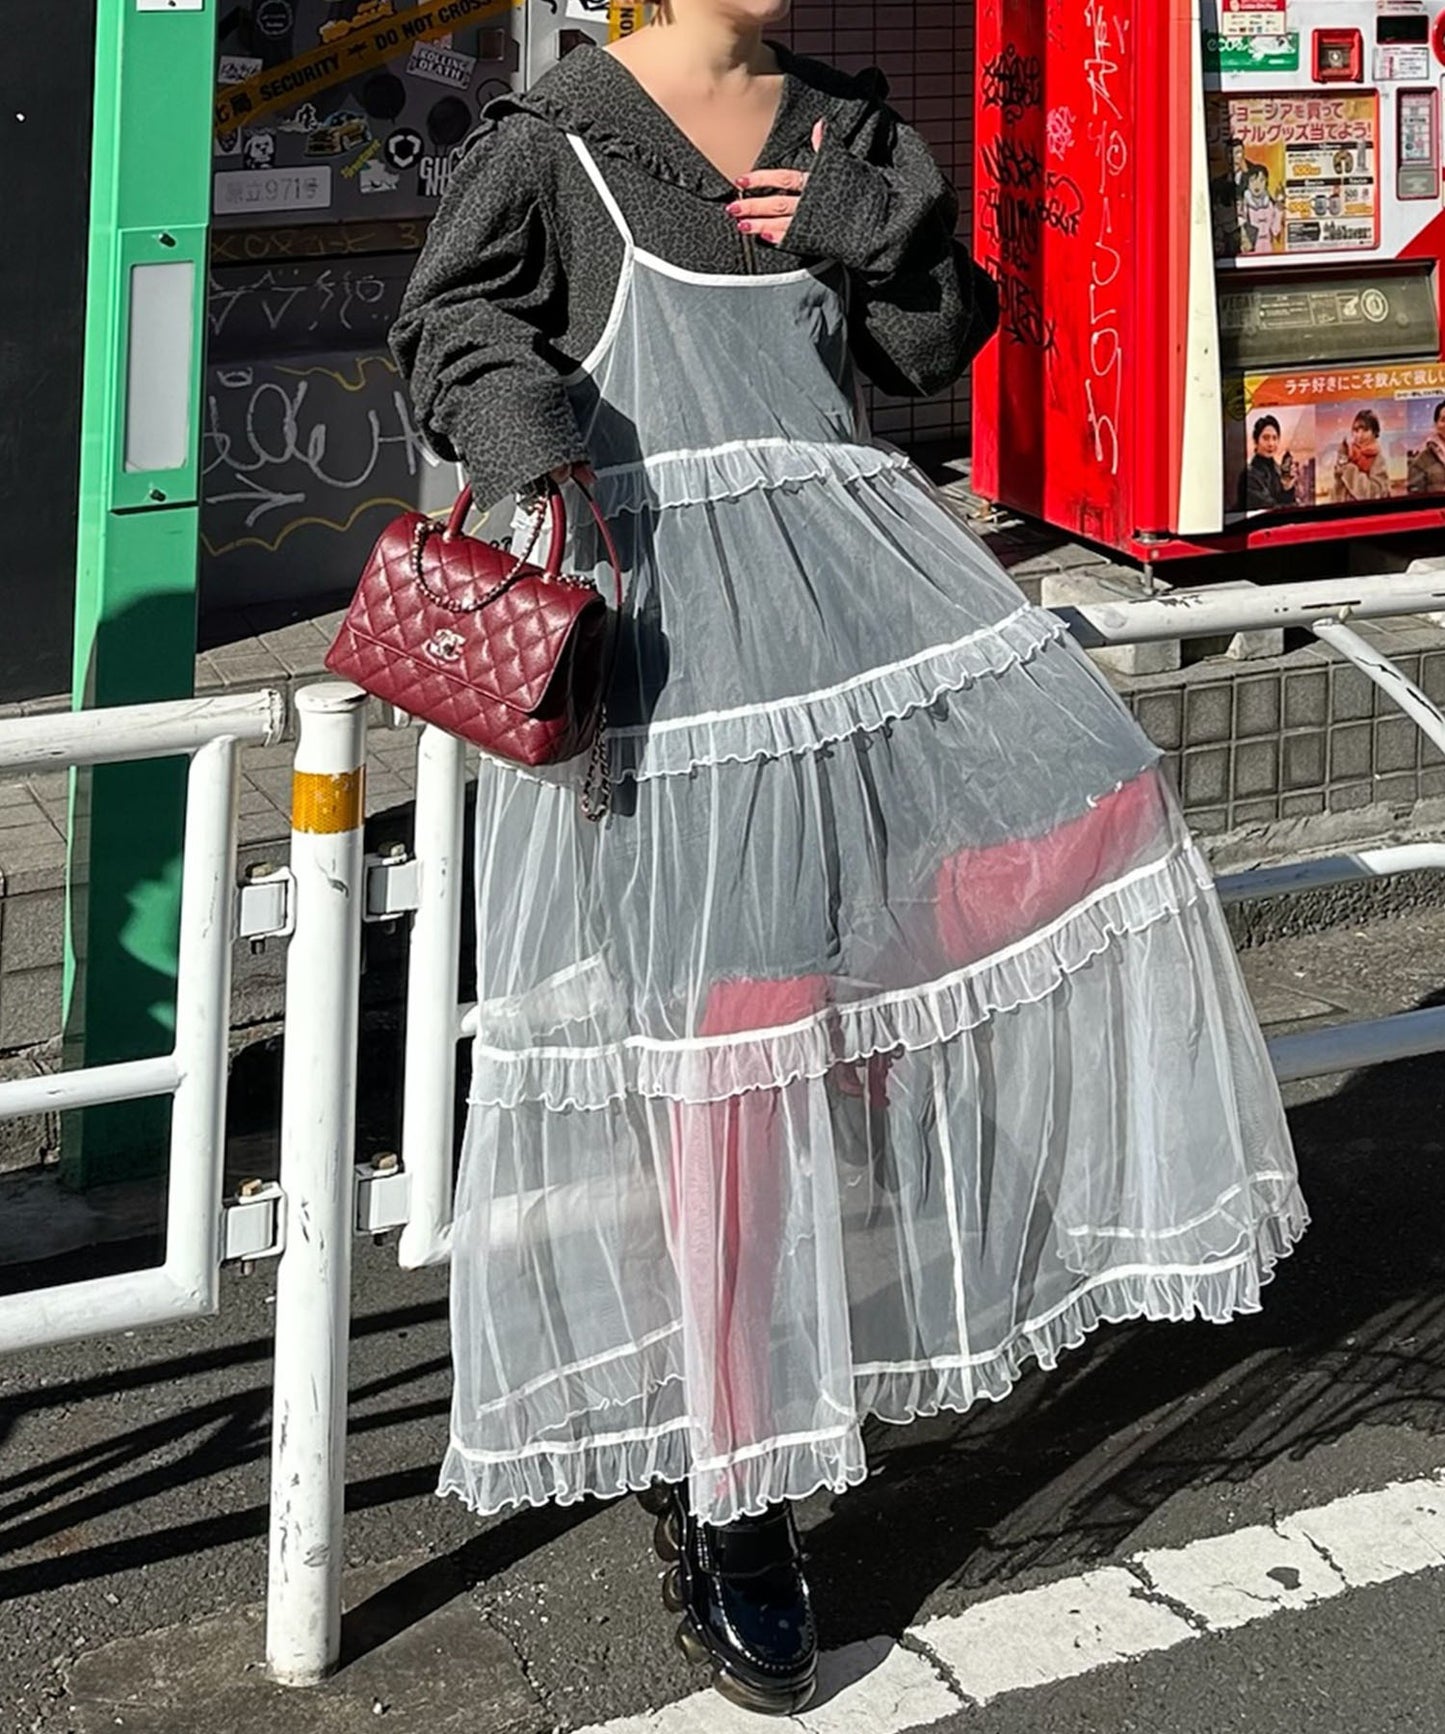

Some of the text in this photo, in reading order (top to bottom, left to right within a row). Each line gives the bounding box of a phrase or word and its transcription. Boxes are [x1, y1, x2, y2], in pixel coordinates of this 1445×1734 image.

[259, 52, 340, 100] SECURITY
[375, 28, 399, 51] DO
[402, 13, 433, 39] NOT
